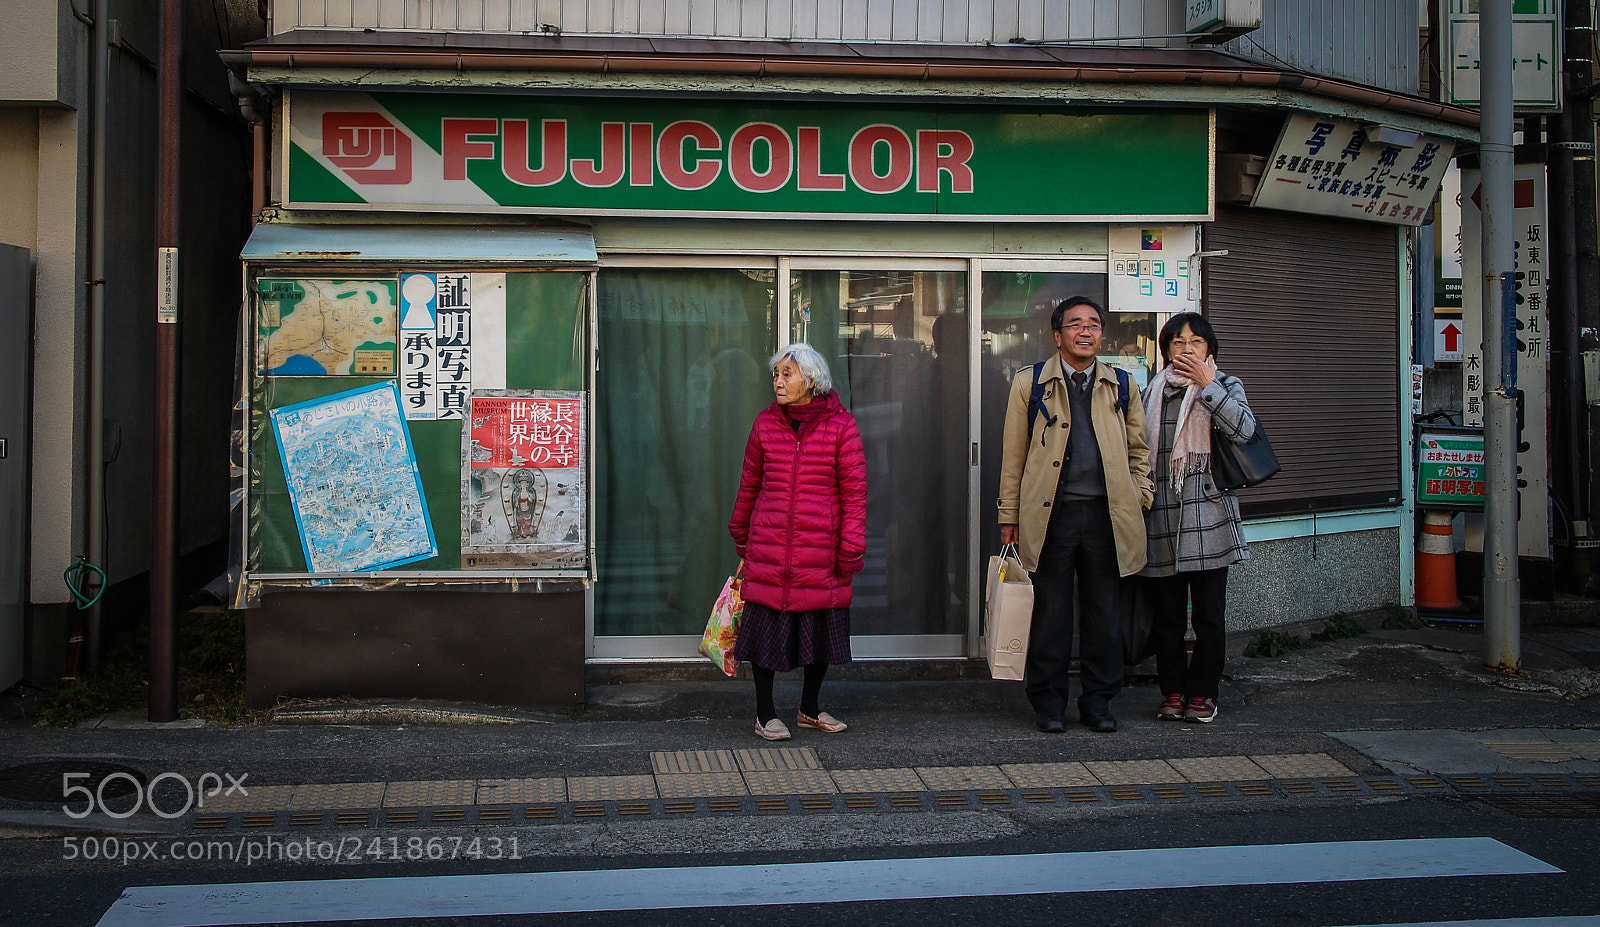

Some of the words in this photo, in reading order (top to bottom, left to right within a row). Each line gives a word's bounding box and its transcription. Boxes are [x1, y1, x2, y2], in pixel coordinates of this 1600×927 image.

[442, 117, 975, 195] FUJICOLOR
[1274, 154, 1348, 177] 各種証明写真
[1306, 175, 1387, 200] ご家族記念写真
[1364, 166, 1431, 192] スピード写真
[1526, 224, 1542, 359] 坂東四番札所
[403, 332, 434, 409] 承ります
[438, 274, 470, 420] 証明写真
[474, 407, 508, 415] MUSEUM
[506, 401, 531, 446] 世界
[529, 402, 553, 465] 縁起の
[551, 402, 574, 467] 長谷寺
